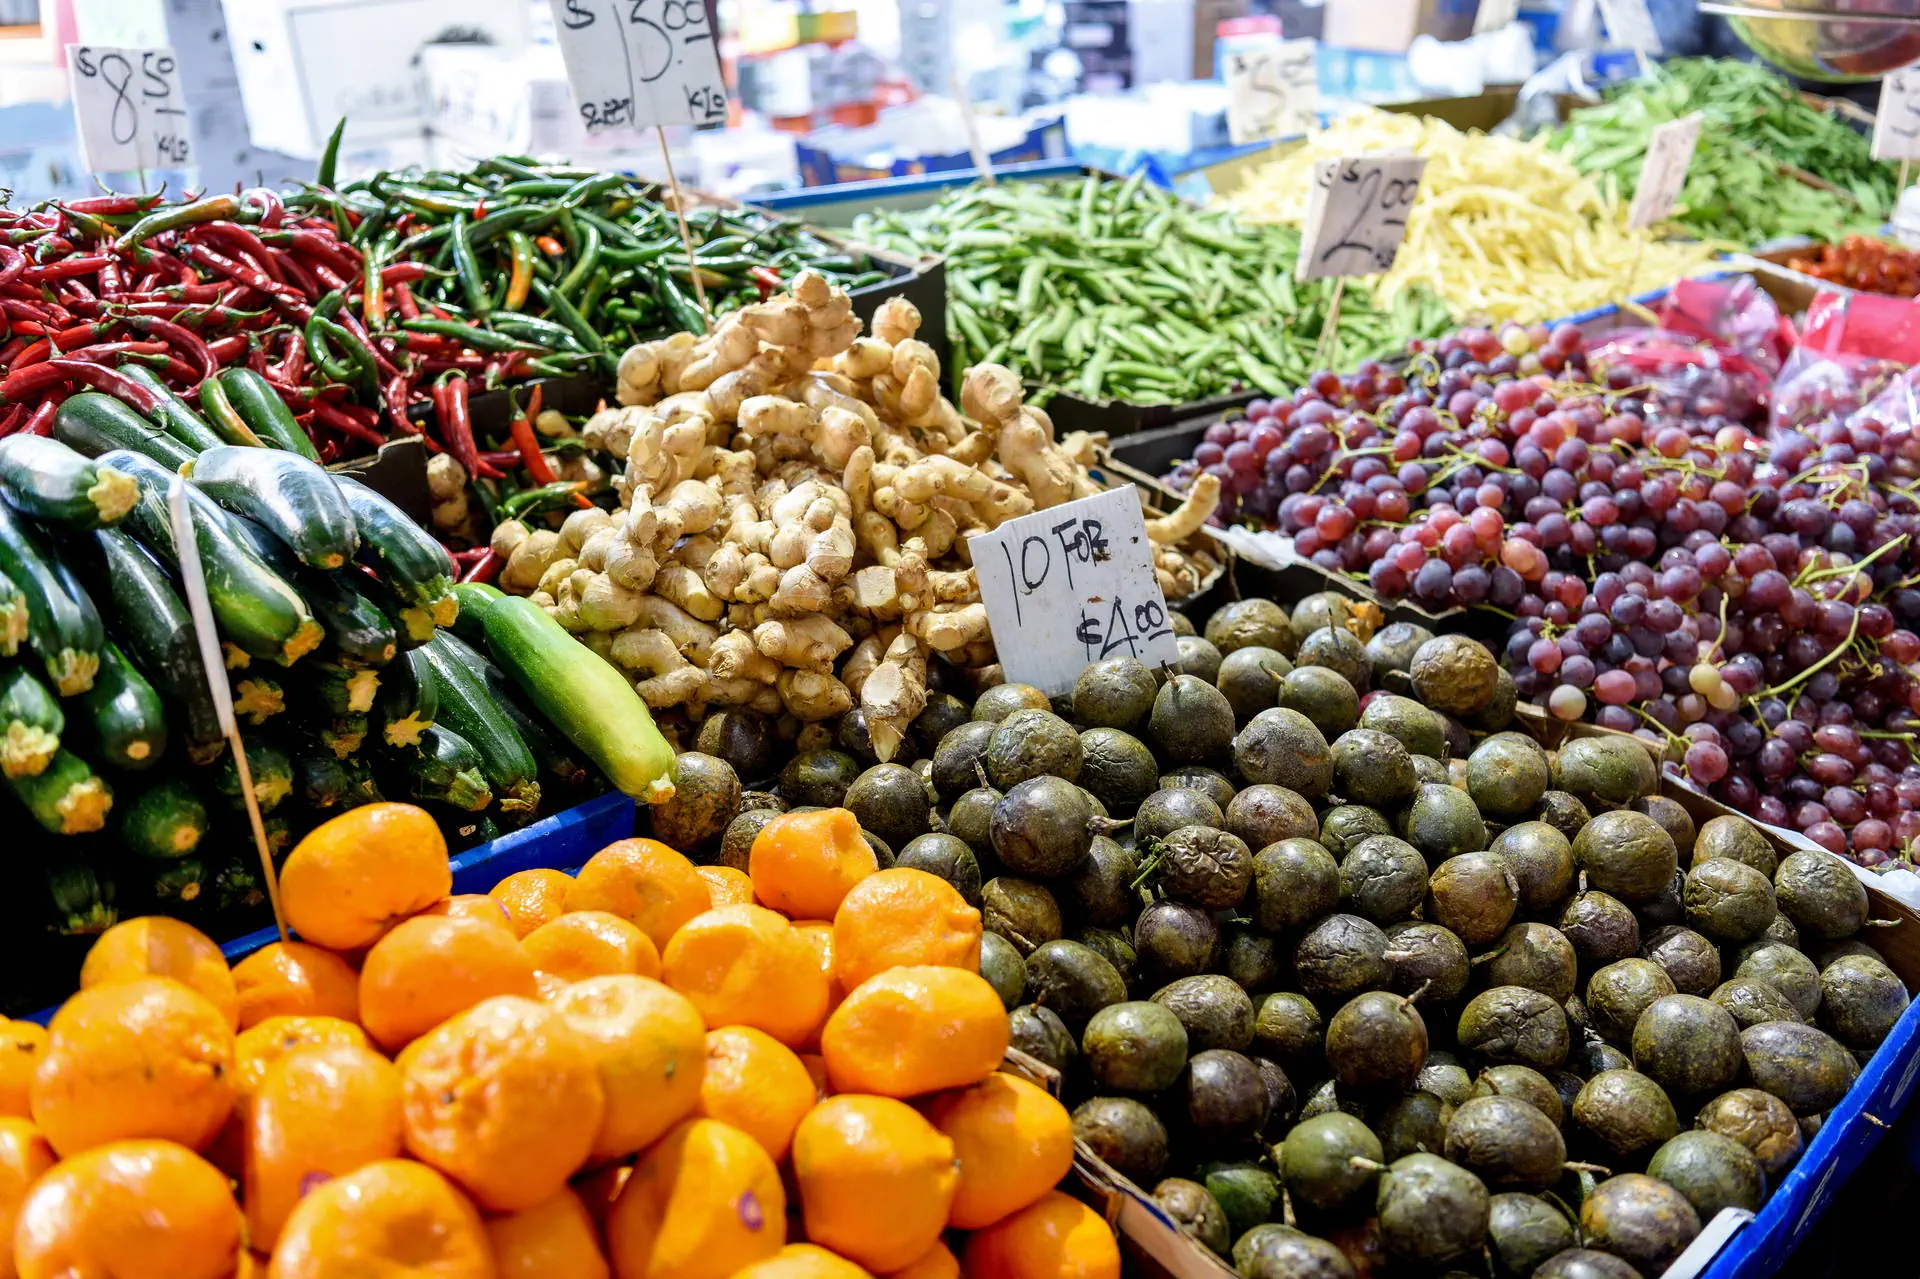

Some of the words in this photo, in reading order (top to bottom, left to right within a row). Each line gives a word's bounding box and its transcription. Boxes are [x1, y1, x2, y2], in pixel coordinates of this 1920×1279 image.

[75, 46, 175, 145] $8.50
[1000, 539, 1050, 628] 10
[1076, 595, 1172, 662] $4.00
